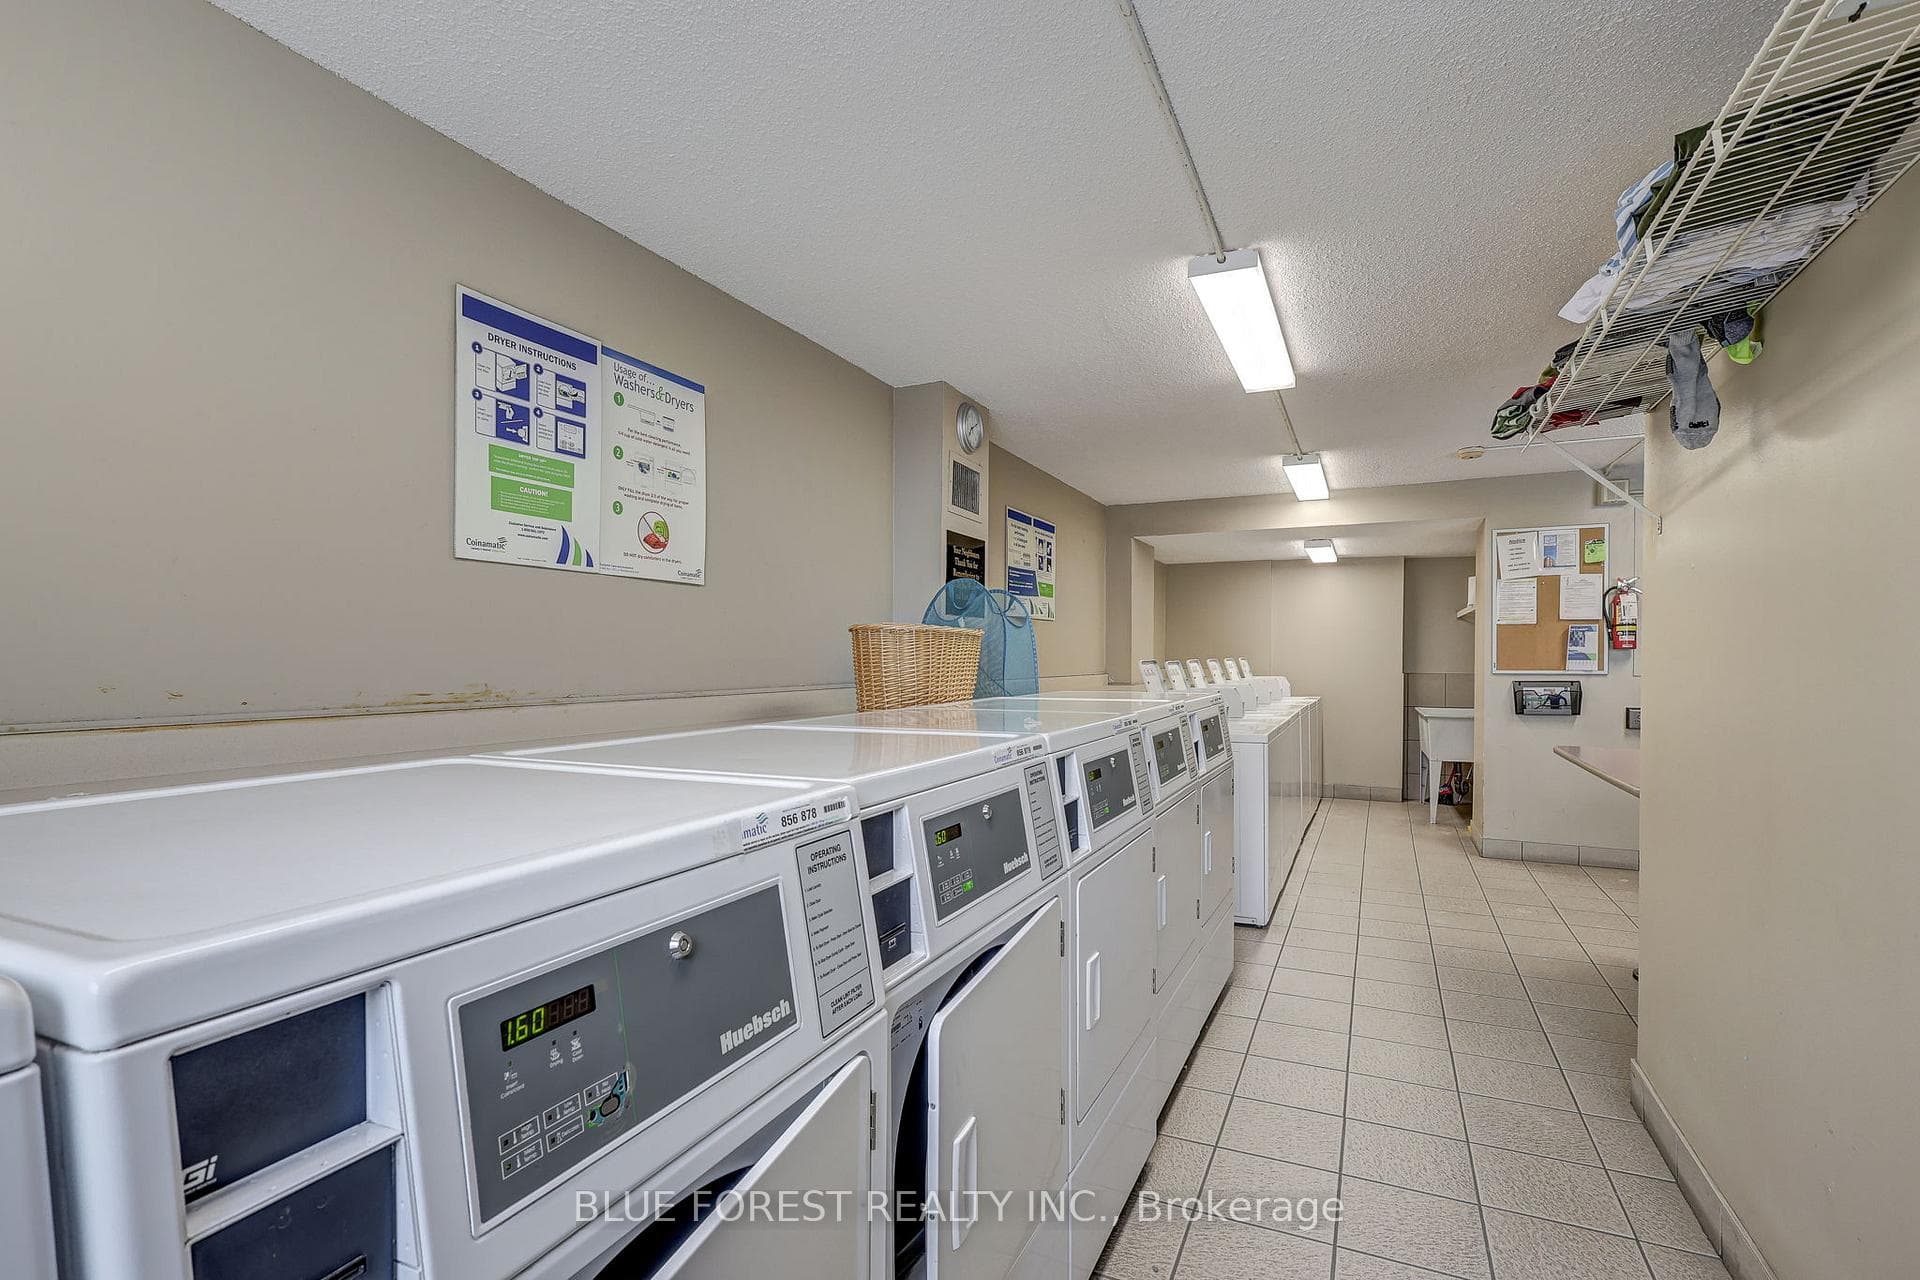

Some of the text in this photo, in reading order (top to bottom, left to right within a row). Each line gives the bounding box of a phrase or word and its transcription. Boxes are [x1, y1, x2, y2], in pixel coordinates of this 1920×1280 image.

[487, 332, 577, 371] DRYER INSTRUCTIONS
[613, 362, 637, 379] Usage
[519, 486, 549, 497] CAUTION!
[466, 537, 506, 550] Coinamatic
[781, 813, 798, 828] 856
[800, 807, 817, 821] 878
[810, 844, 842, 862] OPERATING
[1003, 852, 1029, 874] Huebsch
[806, 853, 847, 875] INSTRUCTIONS
[507, 1007, 545, 1046] 1.60
[720, 998, 791, 1056] Huebsch
